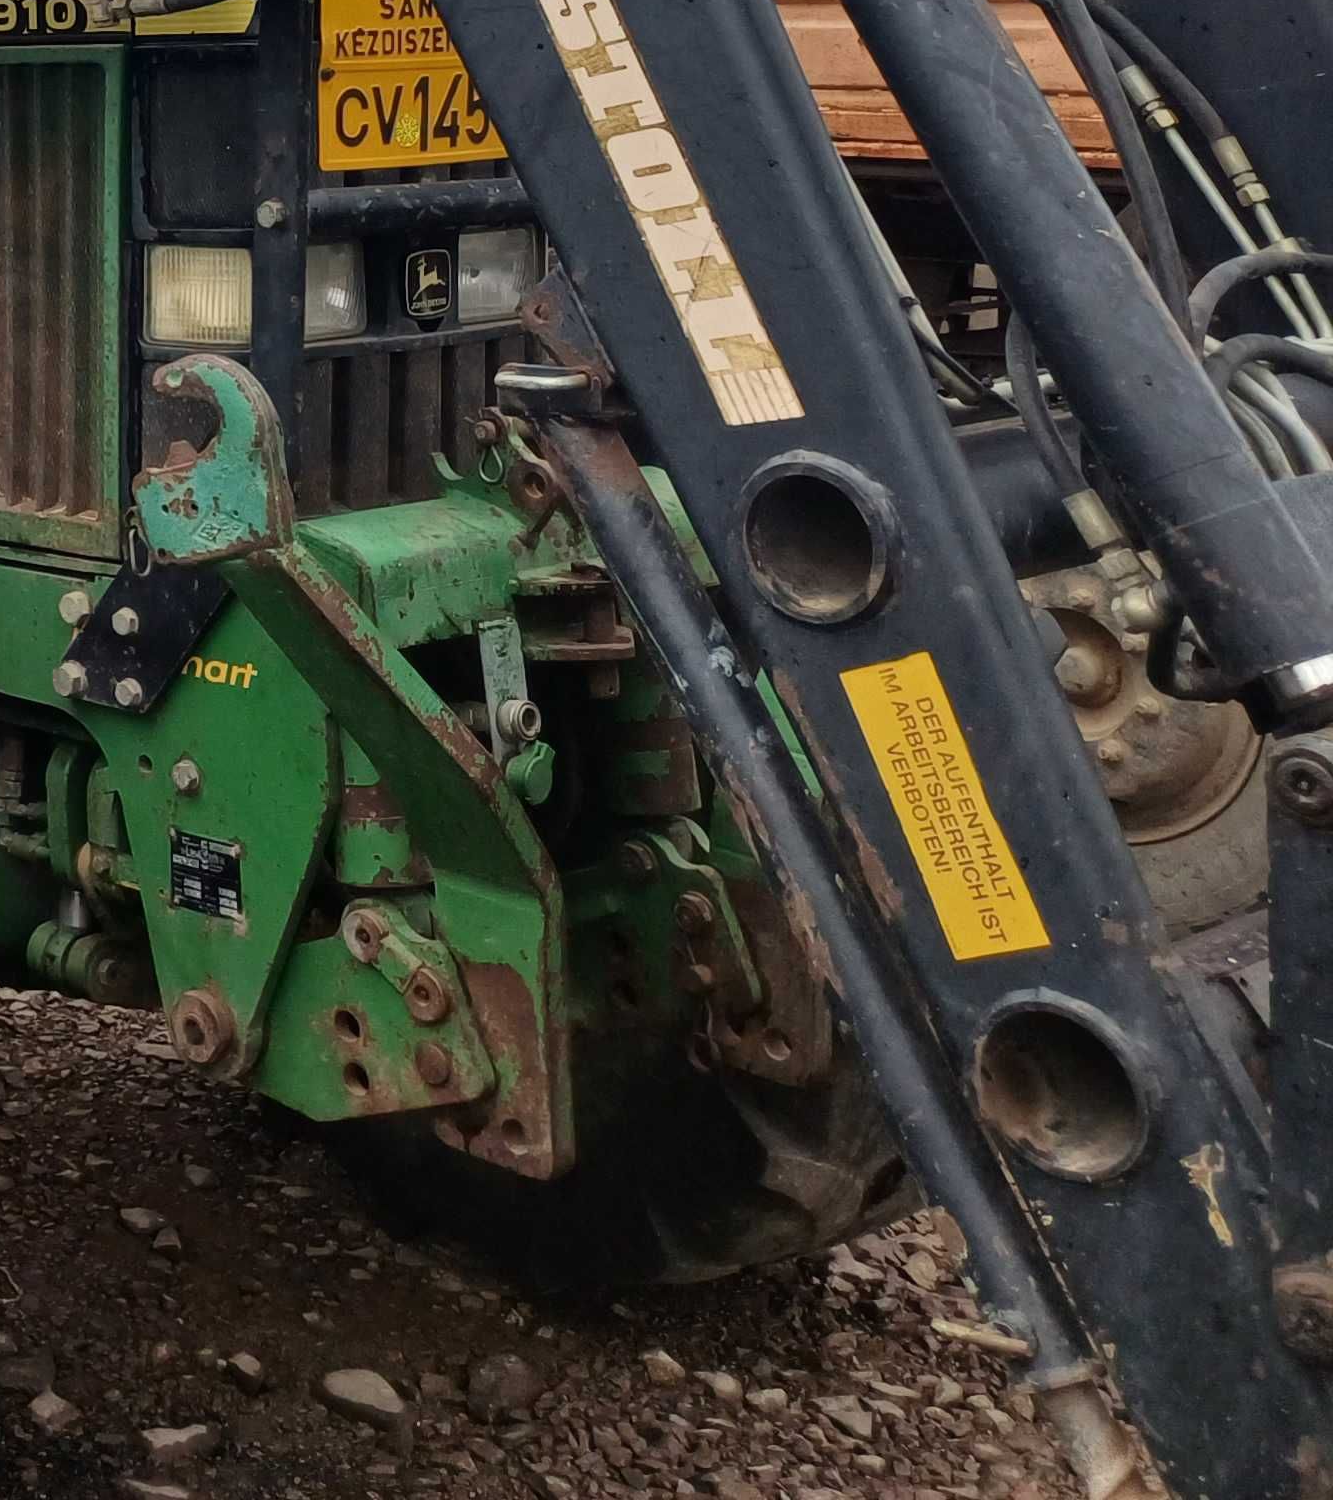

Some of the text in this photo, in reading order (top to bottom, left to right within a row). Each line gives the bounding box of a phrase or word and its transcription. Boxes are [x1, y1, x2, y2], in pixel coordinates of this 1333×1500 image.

[335, 85, 404, 148] CV
[879, 666, 1009, 944] IM ARBEITSBEREICH IST
[886, 741, 953, 875] VERBOTEN!
[915, 696, 1016, 901] DER AUFENTHALT
